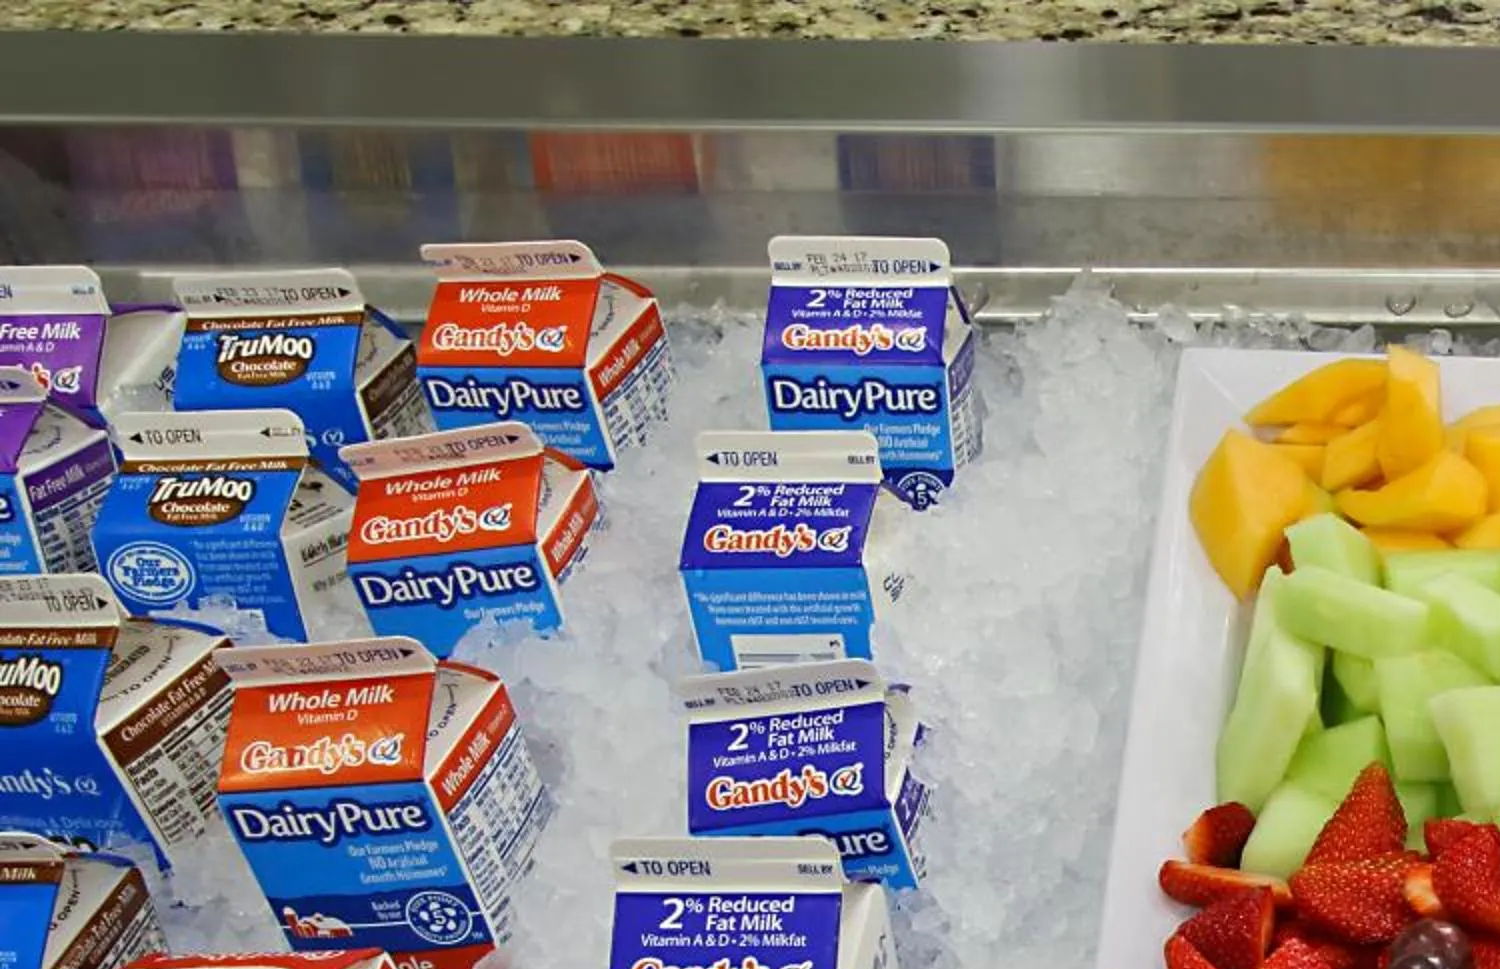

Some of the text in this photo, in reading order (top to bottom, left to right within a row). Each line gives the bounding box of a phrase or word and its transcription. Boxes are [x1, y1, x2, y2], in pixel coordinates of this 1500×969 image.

[536, 254, 570, 265] OPEN
[872, 261, 890, 274] TO
[893, 260, 929, 274] OPEN
[301, 287, 337, 301] OPEN
[459, 285, 562, 303] Whole Milk
[805, 288, 914, 308] 2% Reduced
[480, 304, 521, 314] Vitamin
[843, 298, 904, 310] Fat Milk
[791, 309, 832, 319] Vitamin
[886, 309, 924, 319] Milkfat
[0, 321, 82, 341] Free Milk
[202, 320, 265, 331] Chocolate
[288, 318, 317, 328] Free
[217, 333, 314, 363] TruMoo
[432, 322, 535, 357] Gandy's
[781, 323, 893, 356] Gandy's
[231, 359, 298, 374] Chocolate
[426, 373, 583, 416] DairyPure
[772, 380, 937, 418] DairyPure
[166, 428, 202, 444] OPEN
[467, 435, 507, 451] OPEN
[138, 463, 204, 473] Chocolate
[205, 462, 227, 472] Fat
[228, 461, 258, 471] Free
[722, 452, 778, 467] TO OPEN
[151, 476, 253, 503] TruMoo
[385, 468, 503, 496] Whole Milk
[733, 484, 846, 508] 2% Reduced
[769, 495, 833, 508] Fat Milk
[161, 501, 231, 514] Chocolate
[716, 508, 757, 519] Vitamin
[813, 508, 851, 519] Milkfat
[361, 504, 477, 544] Gandy's
[703, 522, 817, 559] Gandy's
[359, 564, 537, 606] DairyPure
[355, 649, 400, 665] OPEN
[268, 684, 396, 713] Whole Milk
[792, 680, 854, 698] TO OPEN
[296, 710, 346, 725] Vitamin
[727, 710, 845, 752] 2% Reduced
[767, 726, 835, 748] Fat Milk
[240, 732, 366, 775] Gandy's
[713, 741, 857, 769] Vitamin D 2% Milkfat
[706, 764, 829, 811] Gandy's
[232, 801, 427, 845] DairyPure
[640, 860, 712, 876] TO OPEN
[658, 895, 796, 931] 2% Reduced
[705, 913, 784, 932] Fat Milk
[641, 933, 808, 948] Vitamin A & D 2% Milkfat
